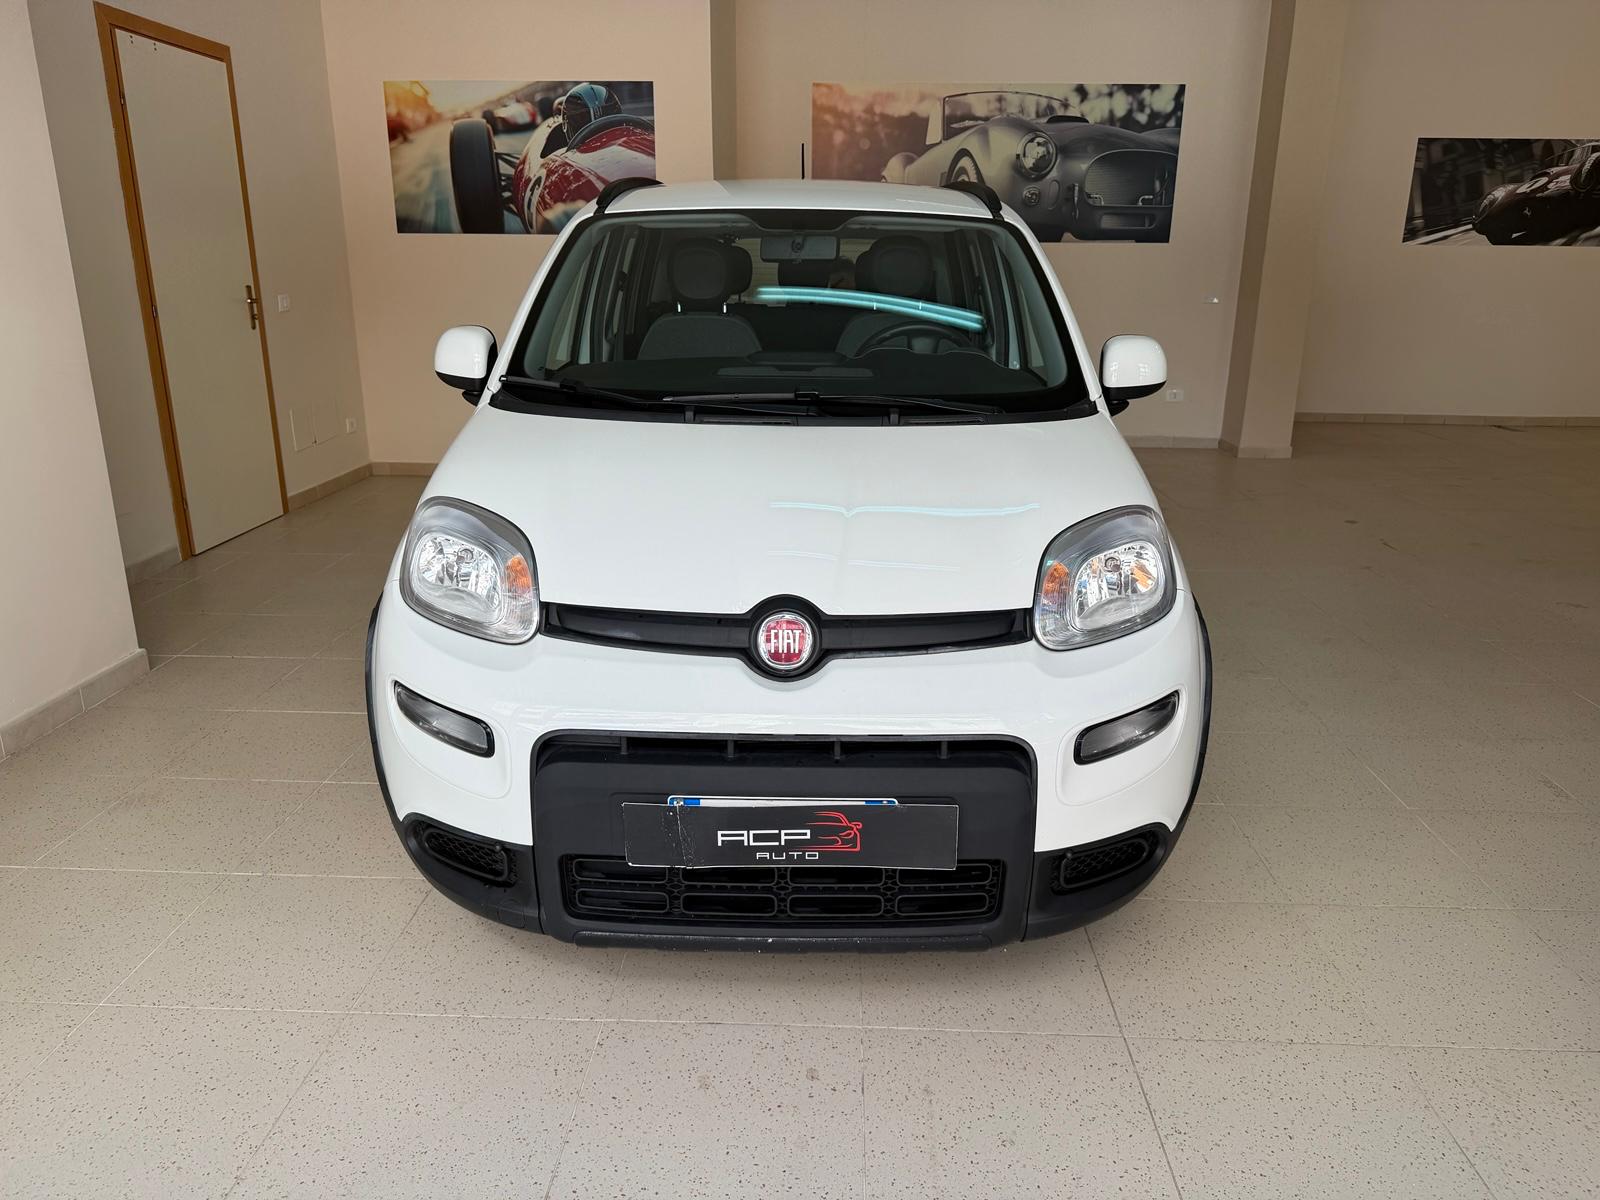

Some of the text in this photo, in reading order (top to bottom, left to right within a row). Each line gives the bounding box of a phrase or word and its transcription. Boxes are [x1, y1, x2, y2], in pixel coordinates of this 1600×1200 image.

[770, 629, 802, 654] FIAT
[717, 829, 811, 847] ACP
[756, 851, 819, 860] AUTO
